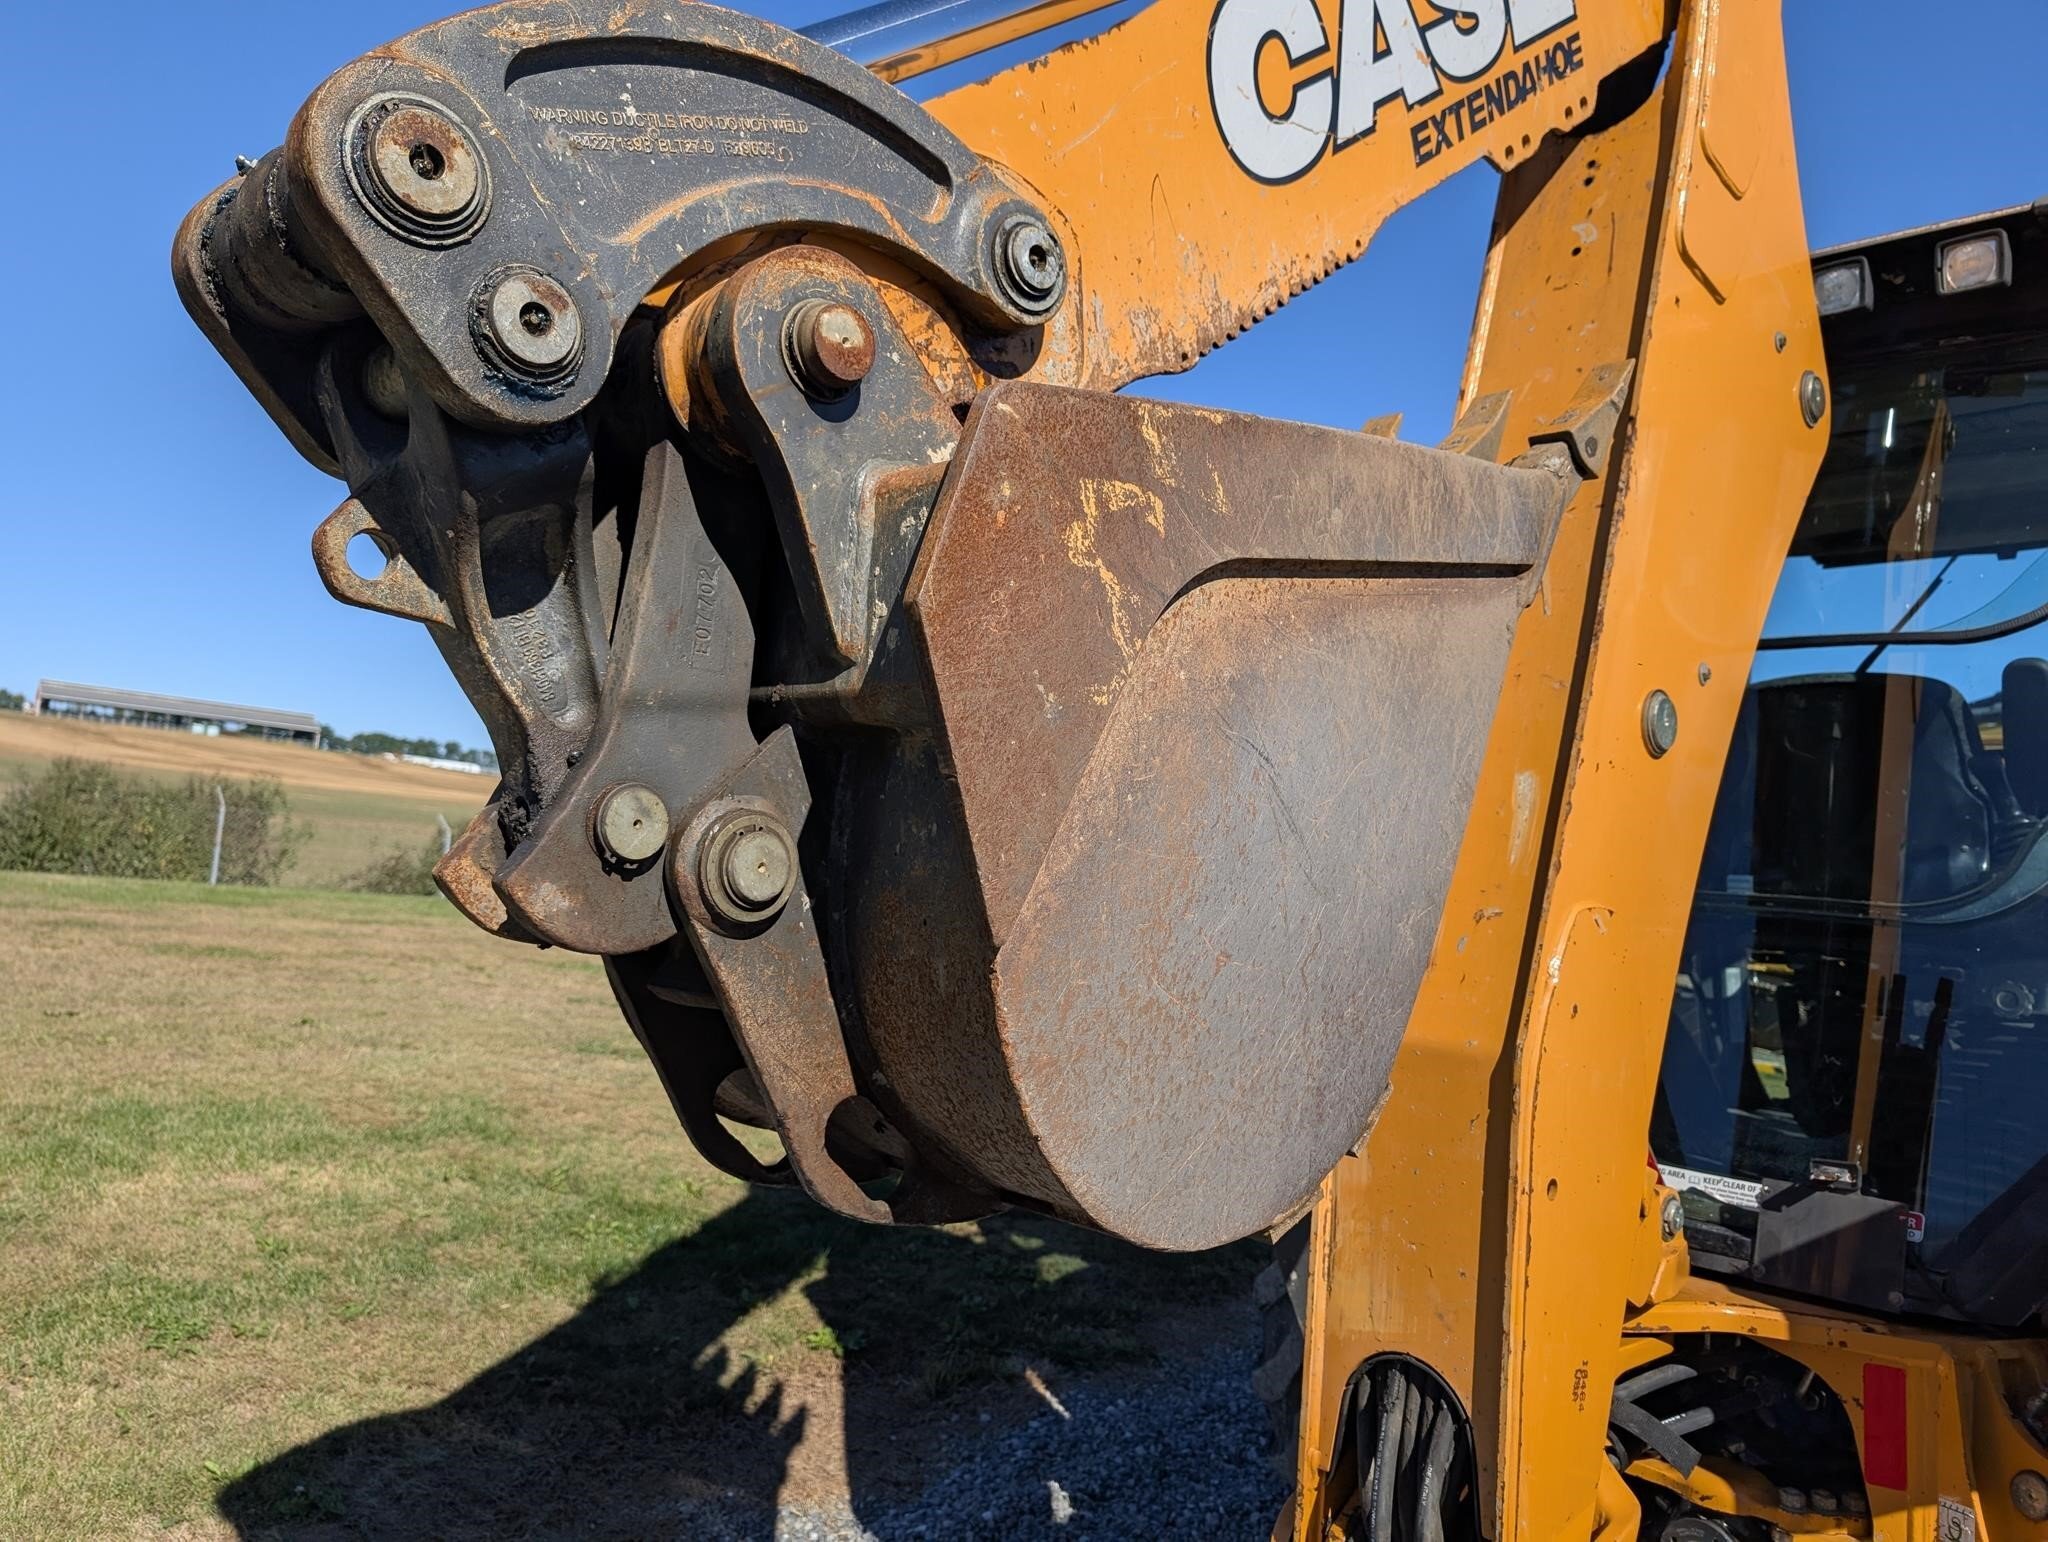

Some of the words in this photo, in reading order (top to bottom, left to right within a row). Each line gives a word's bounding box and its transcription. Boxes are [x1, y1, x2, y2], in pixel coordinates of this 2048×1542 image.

[1206, 0, 1578, 186] CAS
[1410, 32, 1584, 168] EXTENDAHOE
[528, 106, 608, 126] WARNING
[612, 111, 677, 130] DUCTILE
[679, 113, 715, 131] IRON
[716, 114, 738, 132] DO
[738, 116, 768, 133] NOT
[769, 117, 809, 135] WELD
[1667, 1169, 1685, 1180] AREA
[1703, 1176, 1721, 1186] KEEP
[1722, 1180, 1745, 1191] CLEAR
[1747, 1184, 1757, 1193] OF
